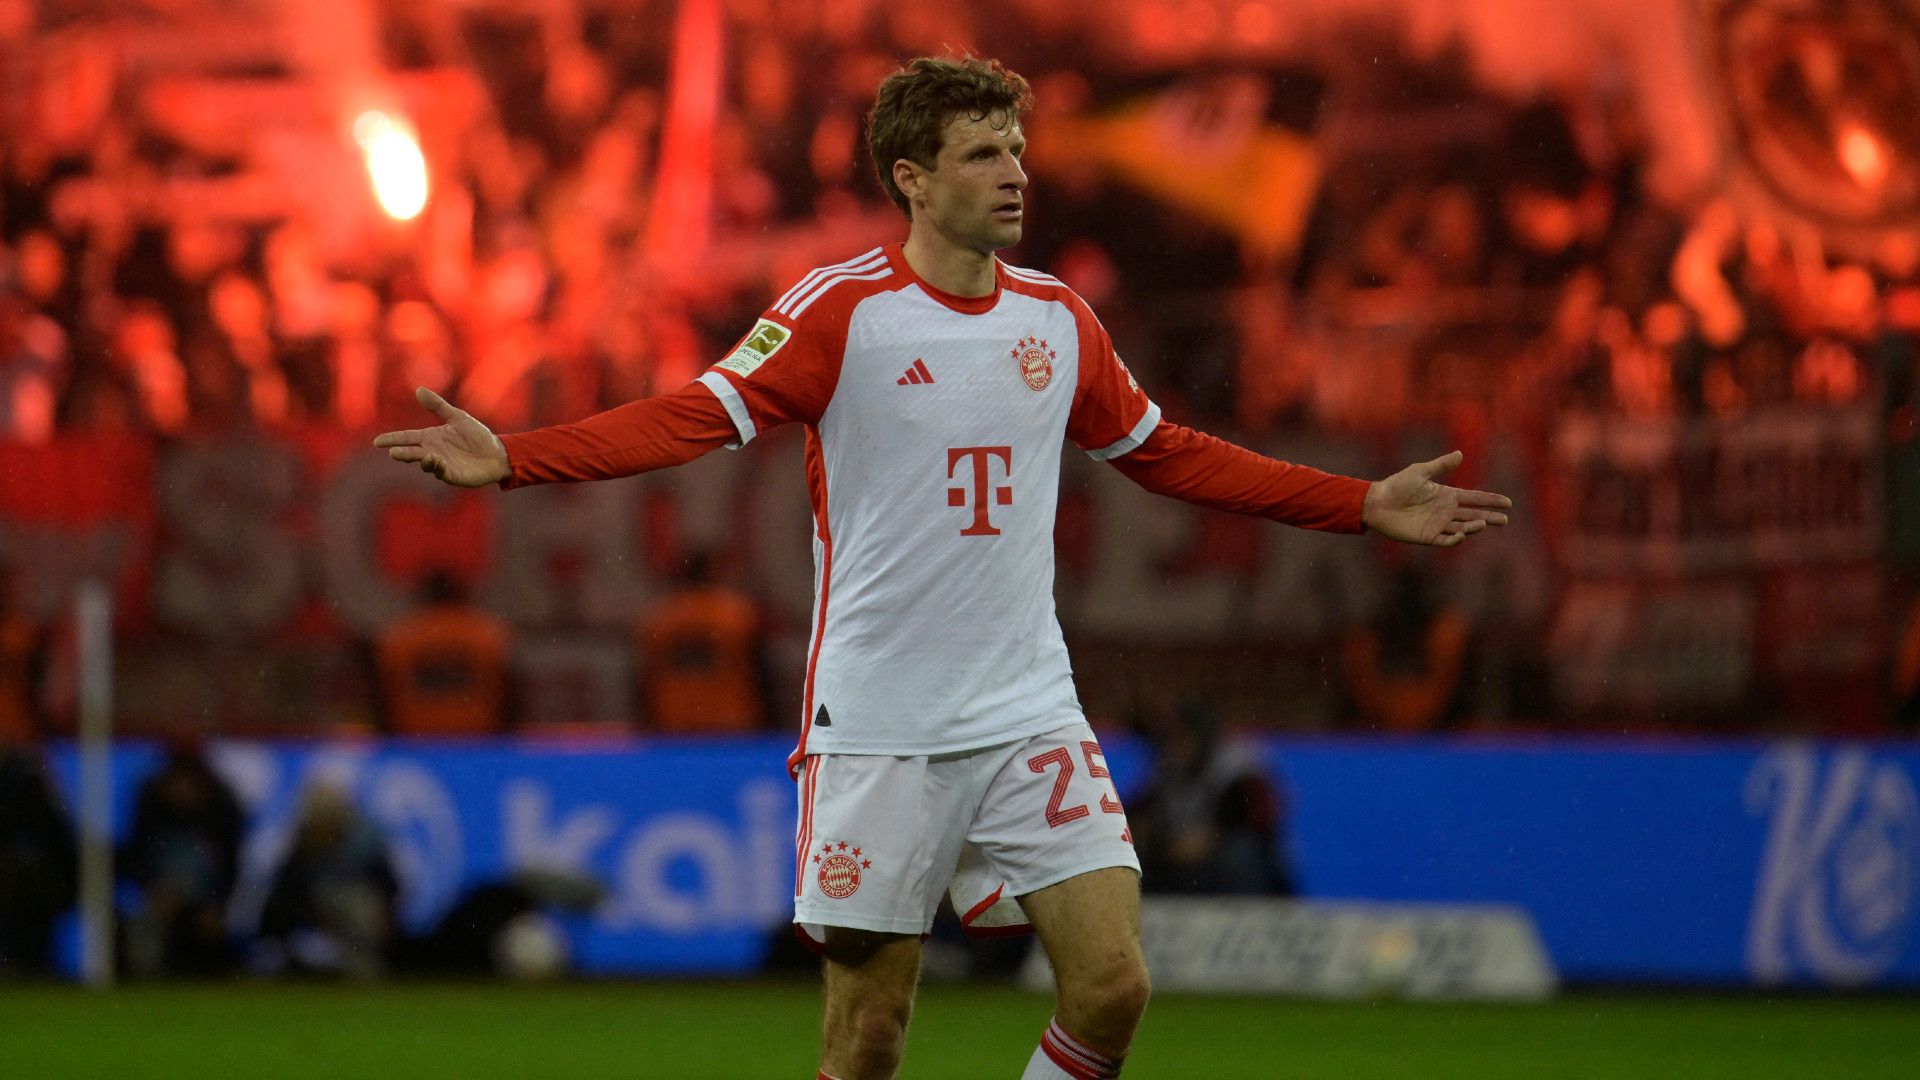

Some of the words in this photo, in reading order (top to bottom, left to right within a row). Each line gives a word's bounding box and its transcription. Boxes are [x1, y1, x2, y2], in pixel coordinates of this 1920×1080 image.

[947, 446, 1012, 536] T
[1027, 740, 1125, 829] 25
[831, 857, 858, 876] BAYERN
